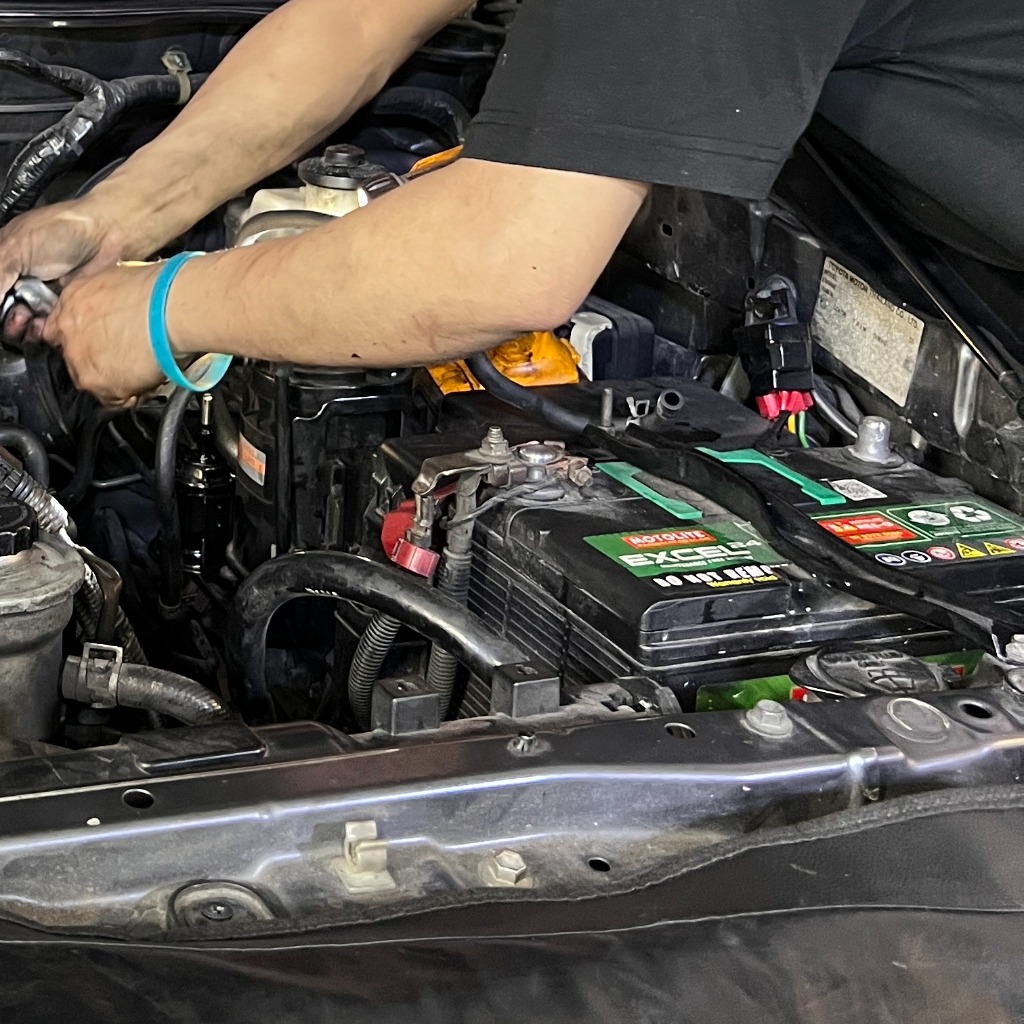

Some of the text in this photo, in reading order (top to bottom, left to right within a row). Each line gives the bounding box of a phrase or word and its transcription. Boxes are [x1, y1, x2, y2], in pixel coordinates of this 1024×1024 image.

[628, 530, 705, 545] MOTOLITE
[619, 544, 751, 567] EXCEL
[653, 574, 683, 587] DO
[683, 571, 723, 584] NOT
